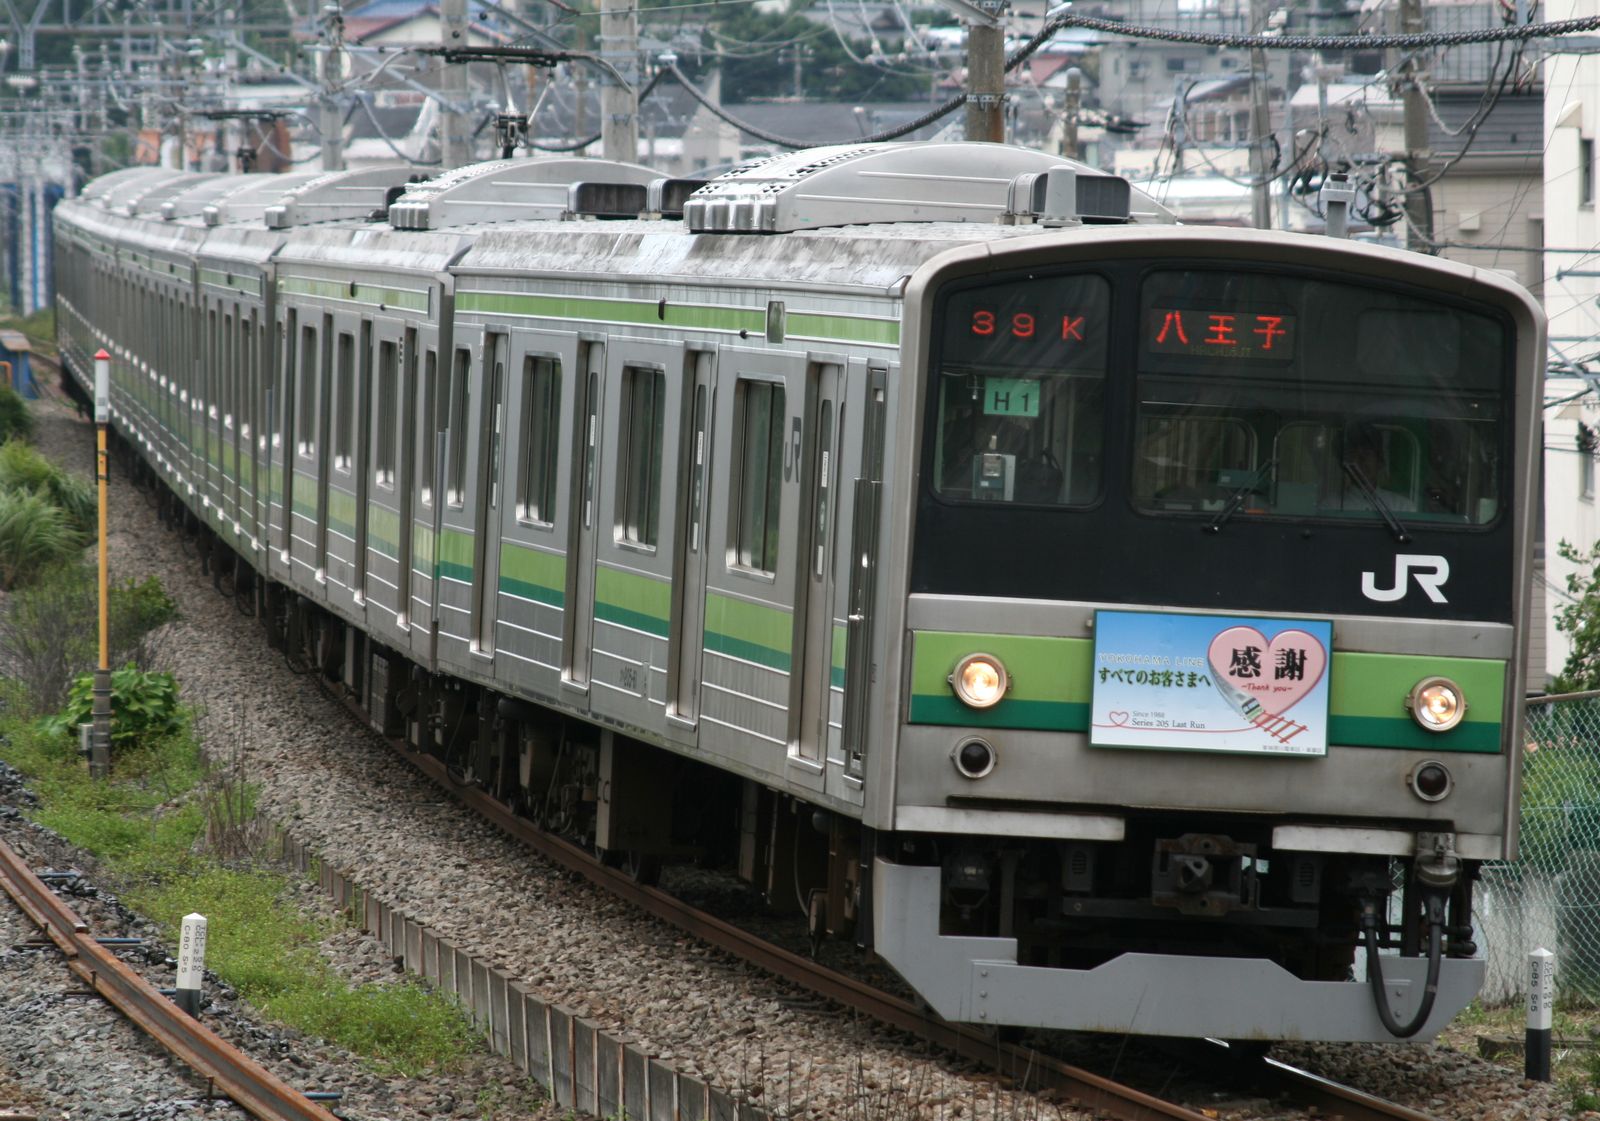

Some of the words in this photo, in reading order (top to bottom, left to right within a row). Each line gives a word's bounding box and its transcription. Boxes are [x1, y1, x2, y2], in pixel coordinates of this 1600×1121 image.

[1155, 309, 1286, 349] 八王子
[783, 415, 802, 483] JR
[1361, 553, 1450, 603] JR
[1098, 652, 1171, 665] YOKOHAMA
[1175, 656, 1205, 667] LINE
[1228, 645, 1308, 682] 感謝
[1098, 666, 1212, 688] すべてのお客さまへ
[1131, 718, 1154, 728] Series
[1156, 719, 1169, 728] 205
[1172, 720, 1187, 729] Last
[1190, 720, 1206, 730] Run
[1132, 710, 1149, 718] Since
